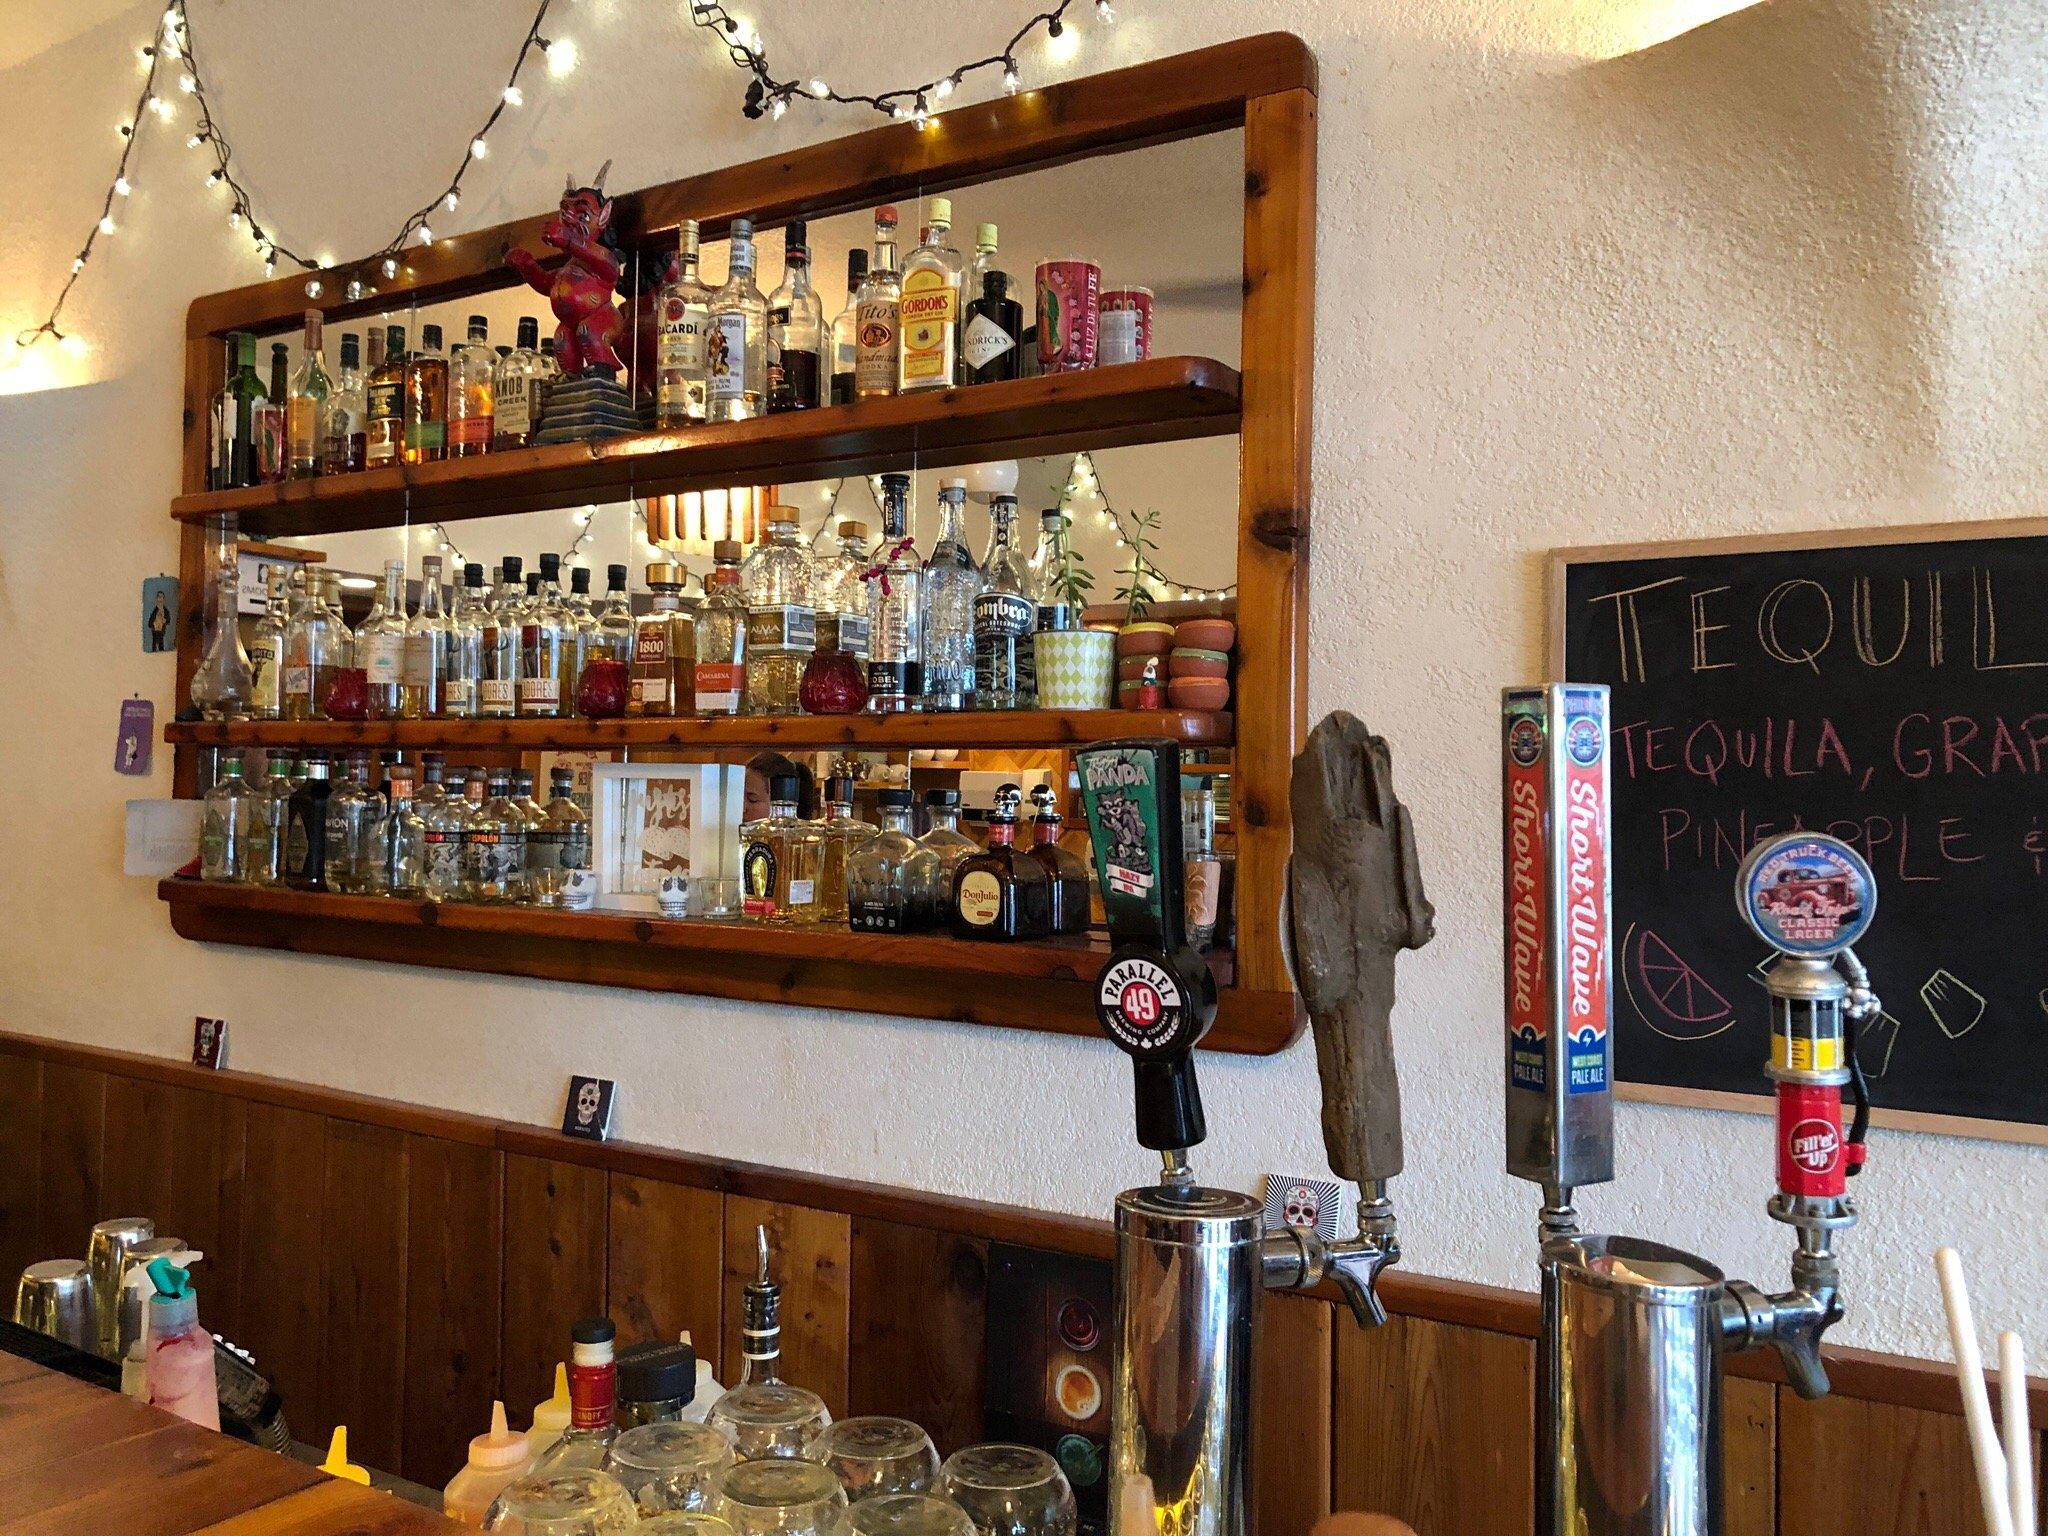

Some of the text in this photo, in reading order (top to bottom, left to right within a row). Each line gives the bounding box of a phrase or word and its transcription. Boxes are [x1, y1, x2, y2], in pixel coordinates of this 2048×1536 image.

[858, 303, 897, 321] Tito's
[900, 294, 949, 315] GORDON'S
[495, 376, 524, 398] KNOB
[497, 395, 528, 406] CREEK
[639, 640, 664, 654] 1800
[1086, 763, 1150, 790] PANDA
[1780, 846, 1827, 863] TRUCK
[1513, 779, 1540, 1013] Short Wave
[1570, 779, 1600, 1018] Short Wave
[1778, 917, 1840, 928] CLASSIC
[1784, 928, 1835, 939] LAGER
[1104, 962, 1175, 1001] PARALLEL
[1125, 987, 1155, 1021] 49
[1146, 1010, 1169, 1036] COMPANY
[1571, 1067, 1604, 1085] PALE ALE
